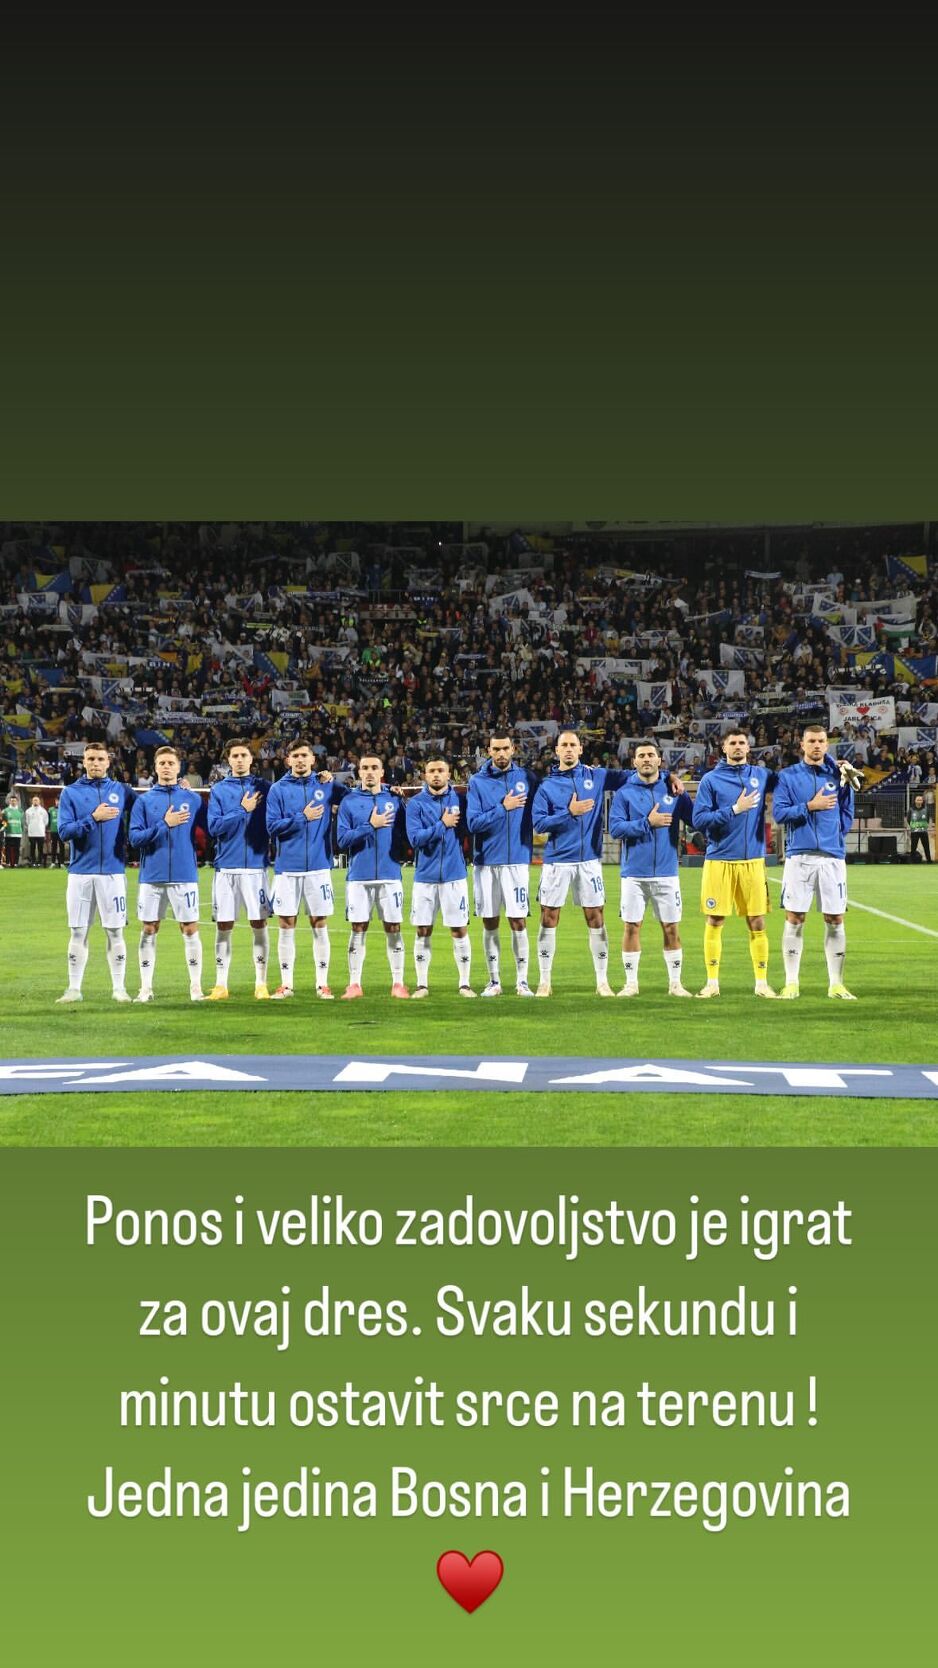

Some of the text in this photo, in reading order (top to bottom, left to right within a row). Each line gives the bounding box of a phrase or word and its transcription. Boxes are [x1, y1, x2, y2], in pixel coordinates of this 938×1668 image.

[320, 884, 331, 900] 15
[590, 875, 602, 893] 18
[184, 891, 196, 908] 17
[258, 888, 265, 904] 8
[513, 887, 526, 903] 16
[674, 891, 681, 907] 5
[112, 896, 126, 913] 10
[459, 896, 466, 911] 4
